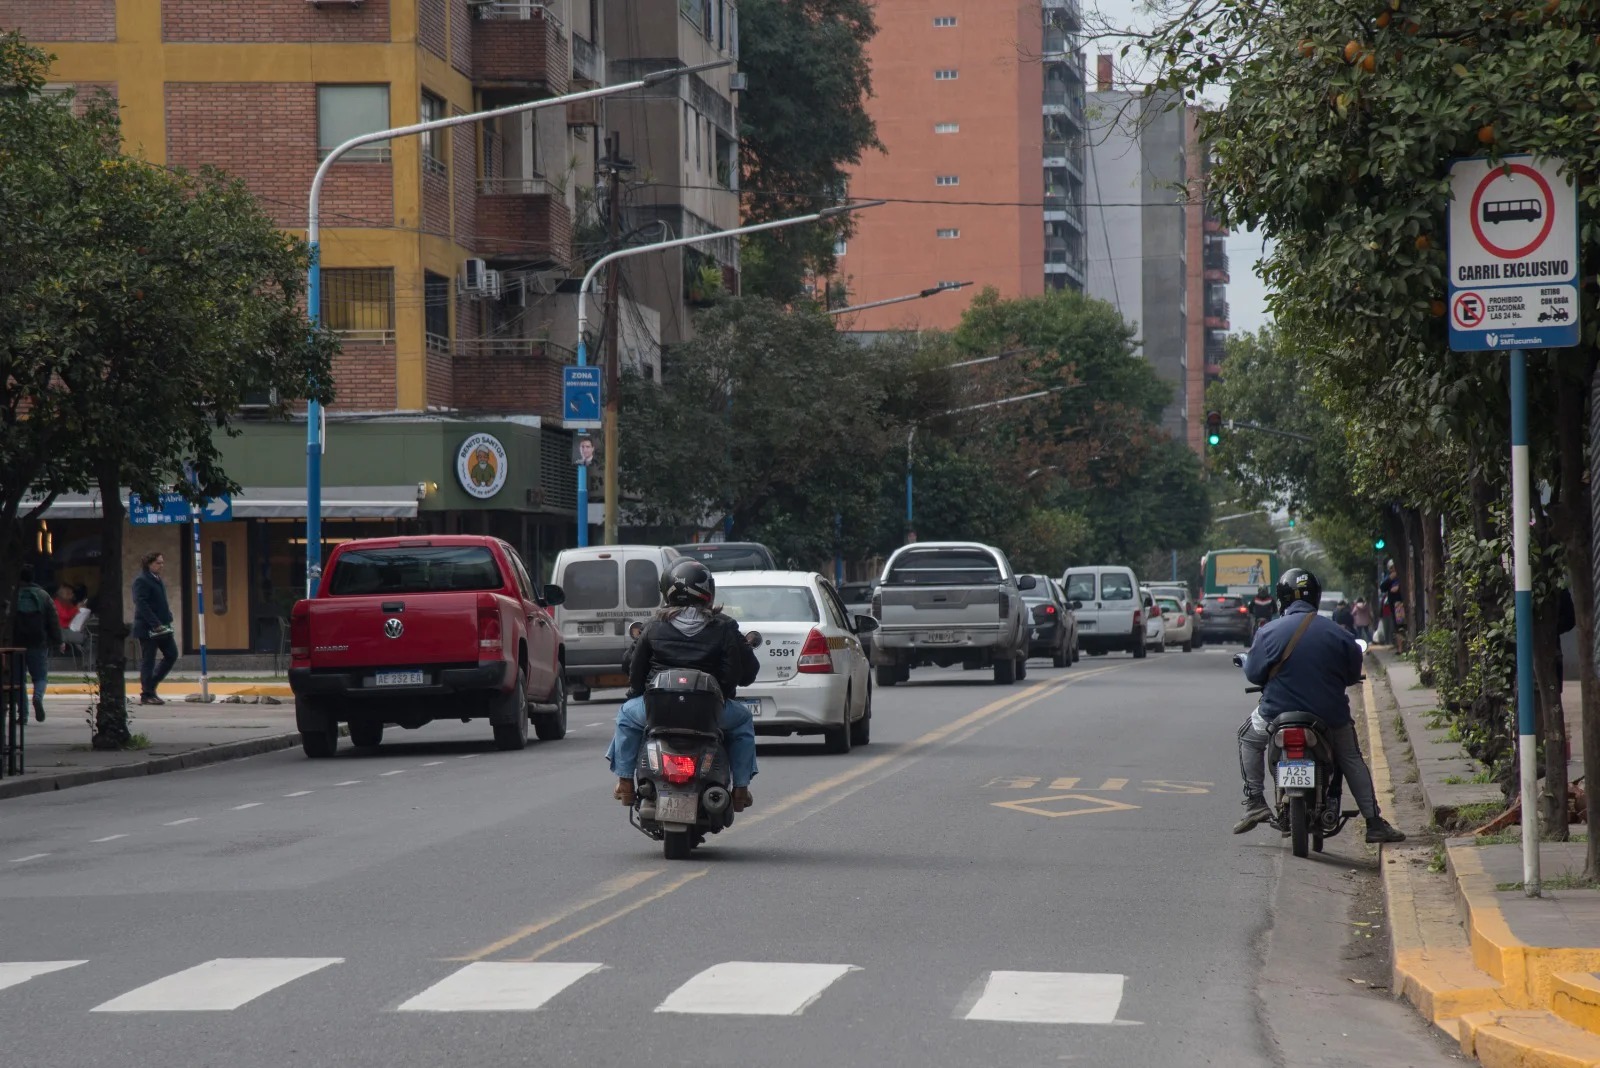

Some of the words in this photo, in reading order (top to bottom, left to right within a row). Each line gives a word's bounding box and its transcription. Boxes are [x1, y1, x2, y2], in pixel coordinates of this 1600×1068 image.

[1458, 264, 1501, 281] CARRIL
[1503, 260, 1569, 279] EXCLUSIVO
[1540, 288, 1560, 296] RETIRO
[1489, 295, 1523, 304] PROHIBIDO
[1487, 303, 1526, 313] ESTACIONAR
[1490, 312, 1503, 320] LAS
[461, 437, 480, 458] BENITO
[481, 436, 504, 458] SANTOS
[165, 494, 183, 503] Abril
[134, 506, 144, 514] de
[769, 648, 795, 657] 5591
[1286, 767, 1307, 776] A25
[1282, 776, 1311, 786] 7ABS
